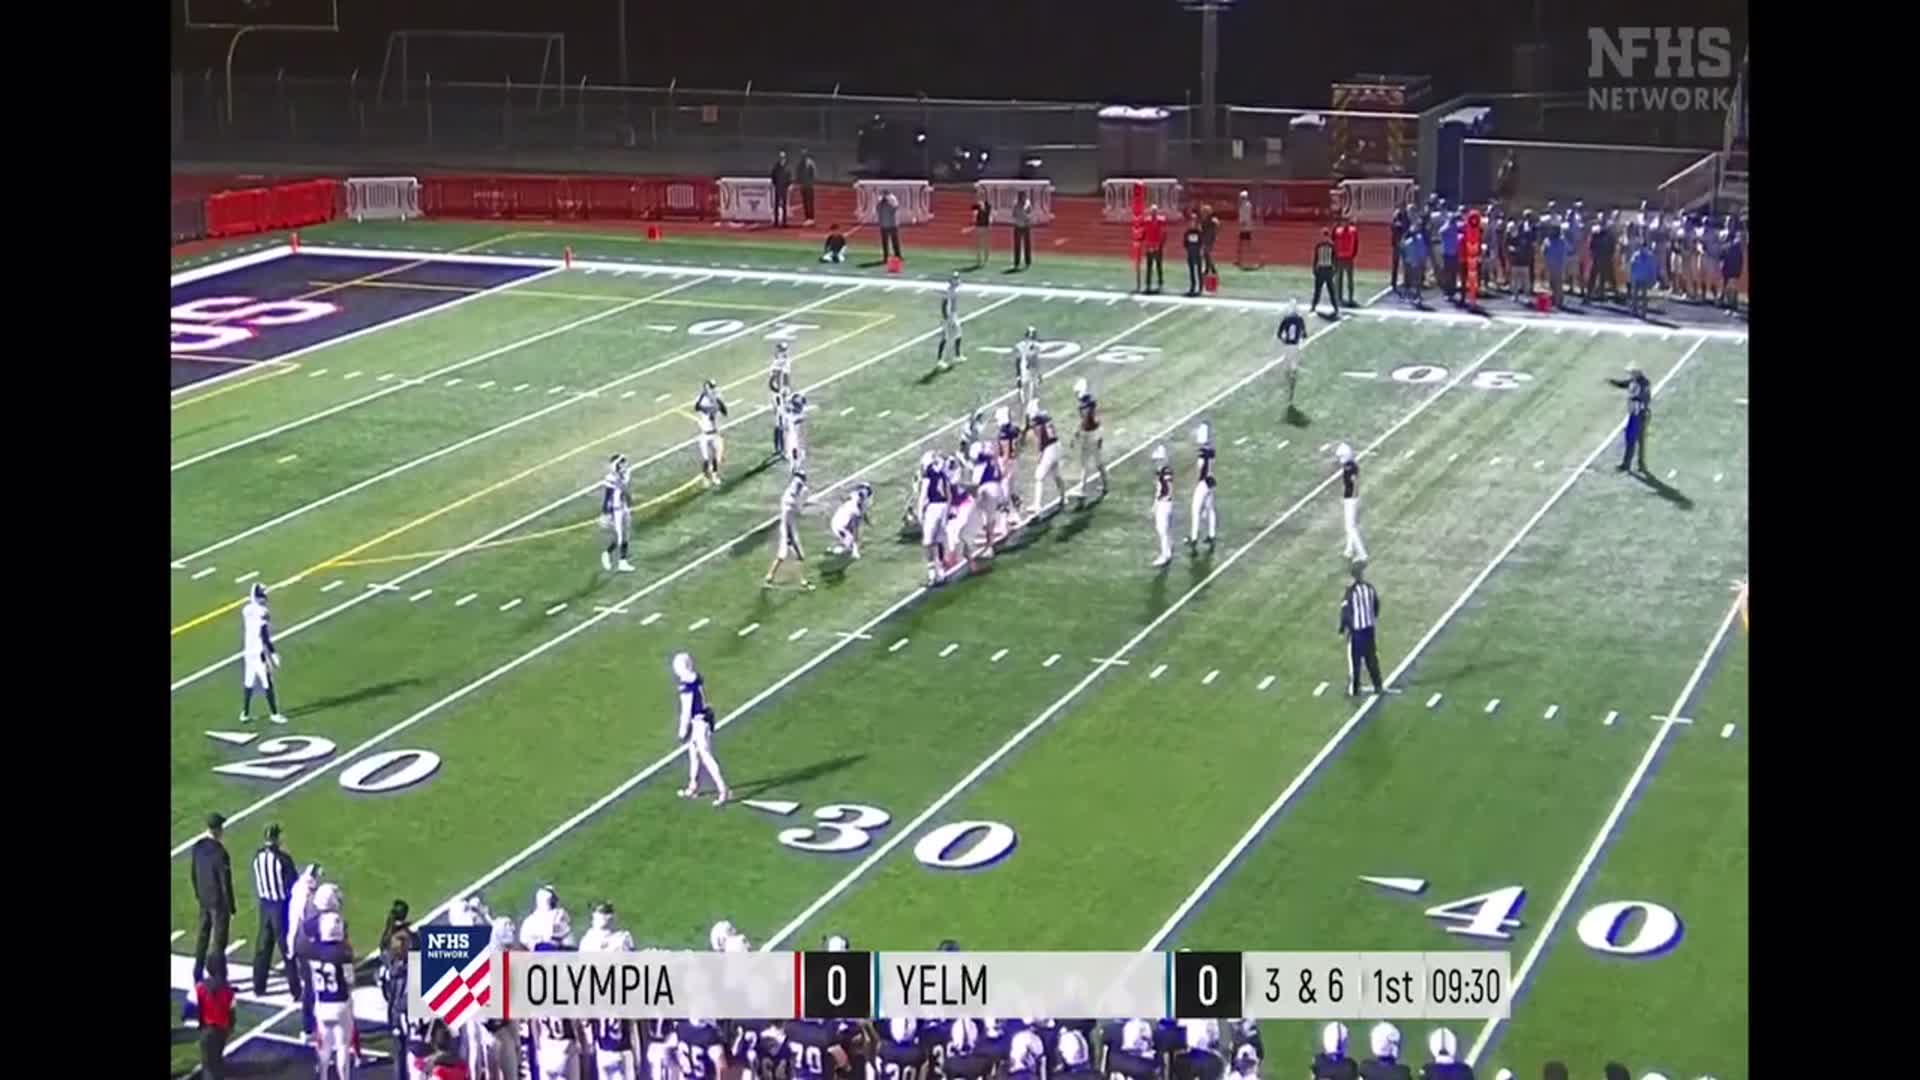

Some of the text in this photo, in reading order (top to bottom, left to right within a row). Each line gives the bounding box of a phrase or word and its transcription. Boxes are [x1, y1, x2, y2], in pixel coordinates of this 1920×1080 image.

[212, 734, 441, 793] 20
[778, 802, 1018, 869] 30
[1424, 884, 1686, 957] 40
[788, 1041, 823, 1075] 70
